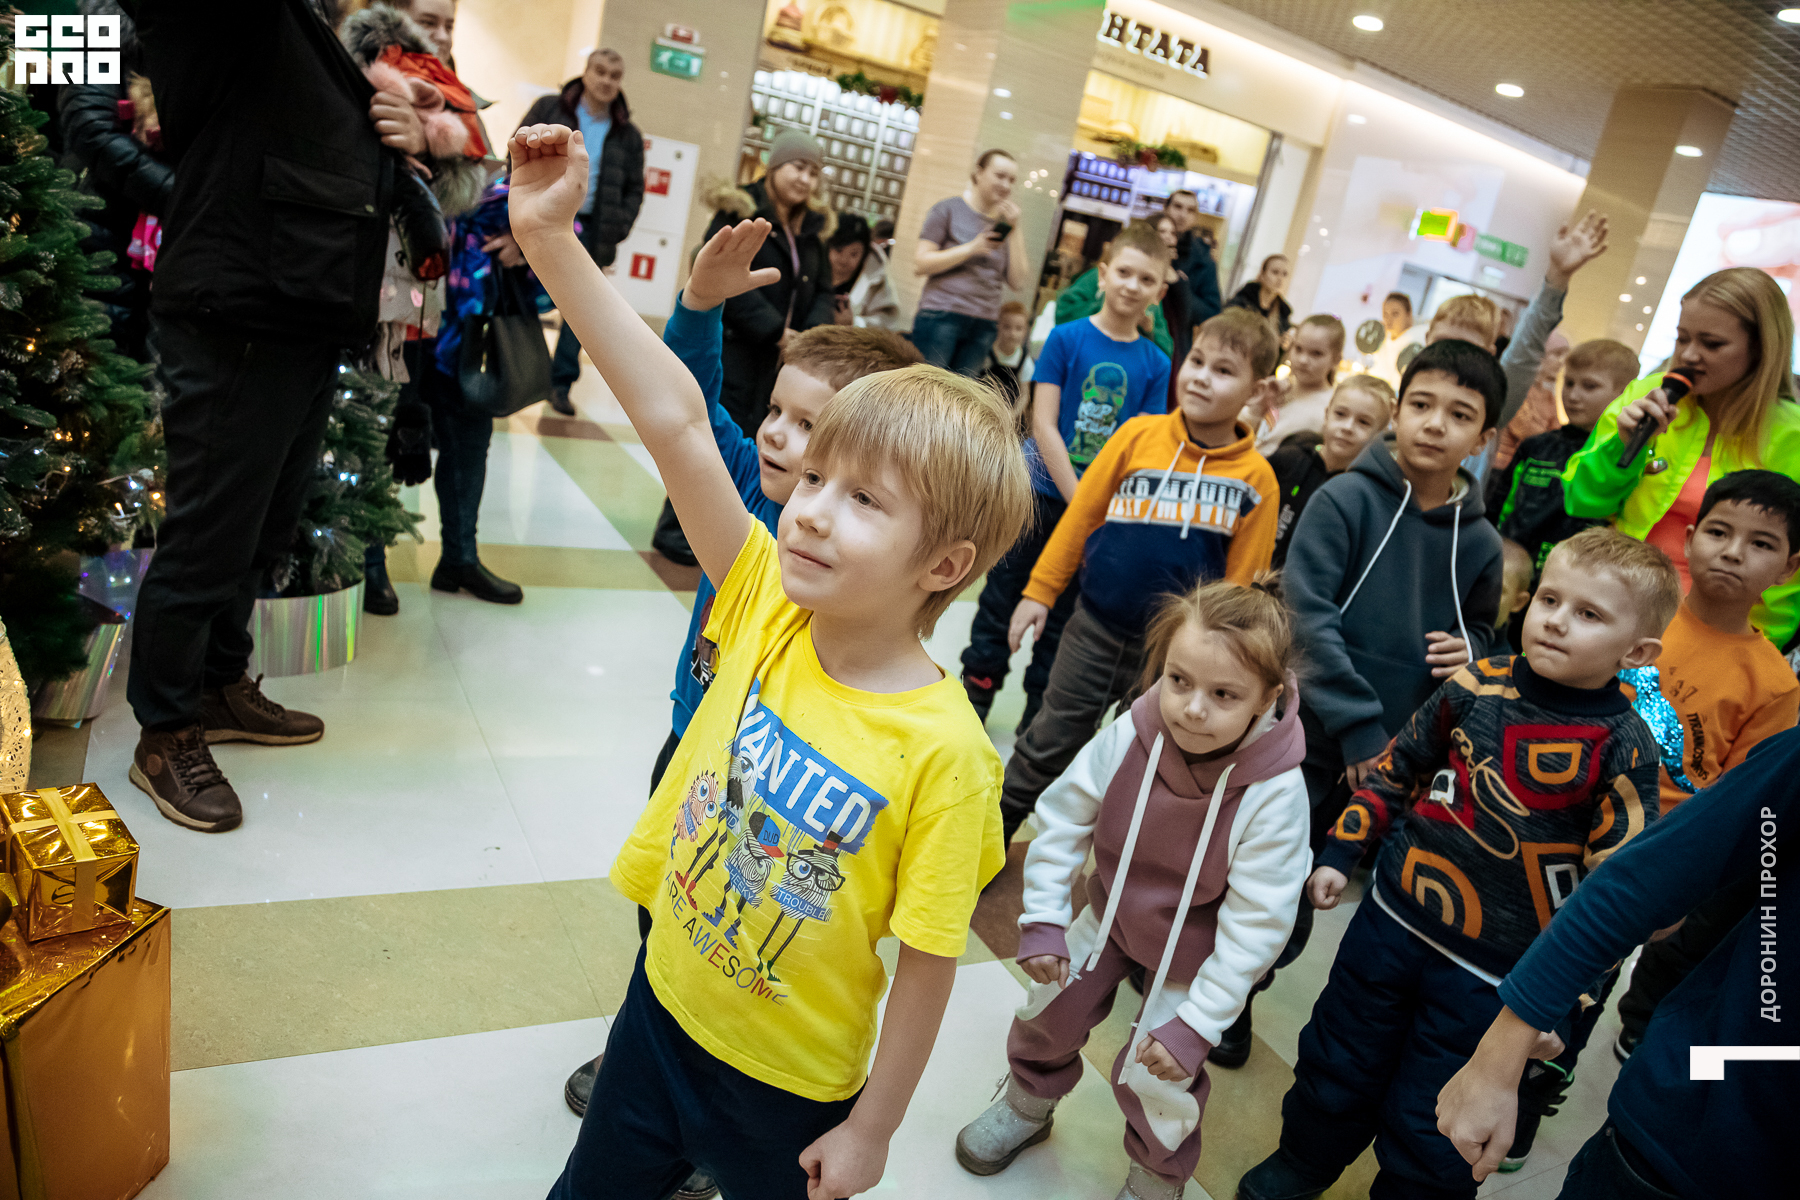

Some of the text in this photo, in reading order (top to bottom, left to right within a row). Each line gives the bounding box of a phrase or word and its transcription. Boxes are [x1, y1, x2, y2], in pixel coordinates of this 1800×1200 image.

[1097, 9, 1210, 79] НТАТА
[763, 829, 779, 845] DUD
[727, 864, 754, 901] HEEKY
[777, 887, 826, 919] TROUBLE
